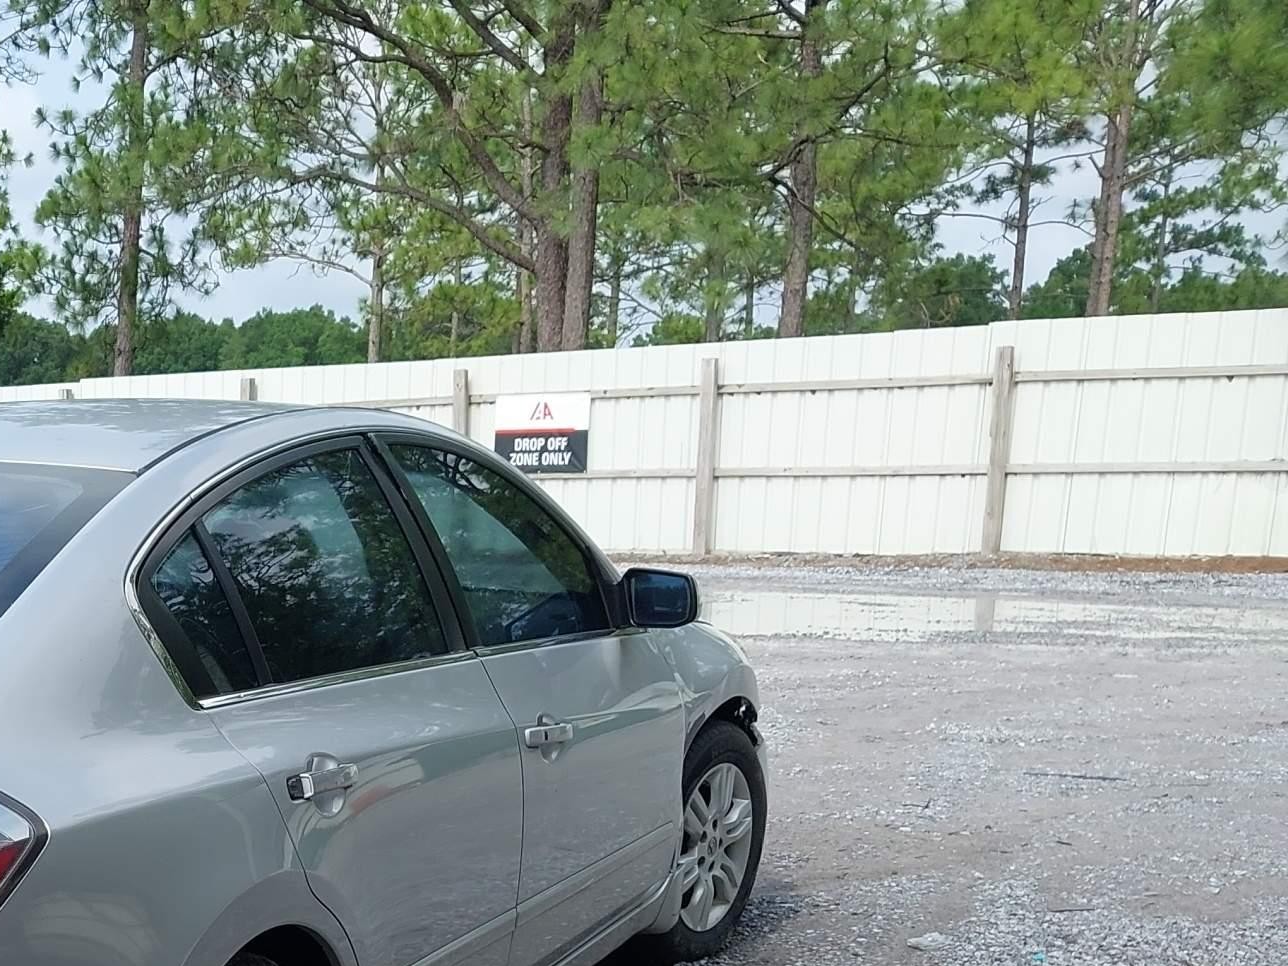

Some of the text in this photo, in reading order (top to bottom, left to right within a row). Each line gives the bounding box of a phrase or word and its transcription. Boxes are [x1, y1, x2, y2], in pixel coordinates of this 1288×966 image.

[514, 436, 568, 451] DROP OFF
[509, 451, 571, 466] ZONE ONLY
